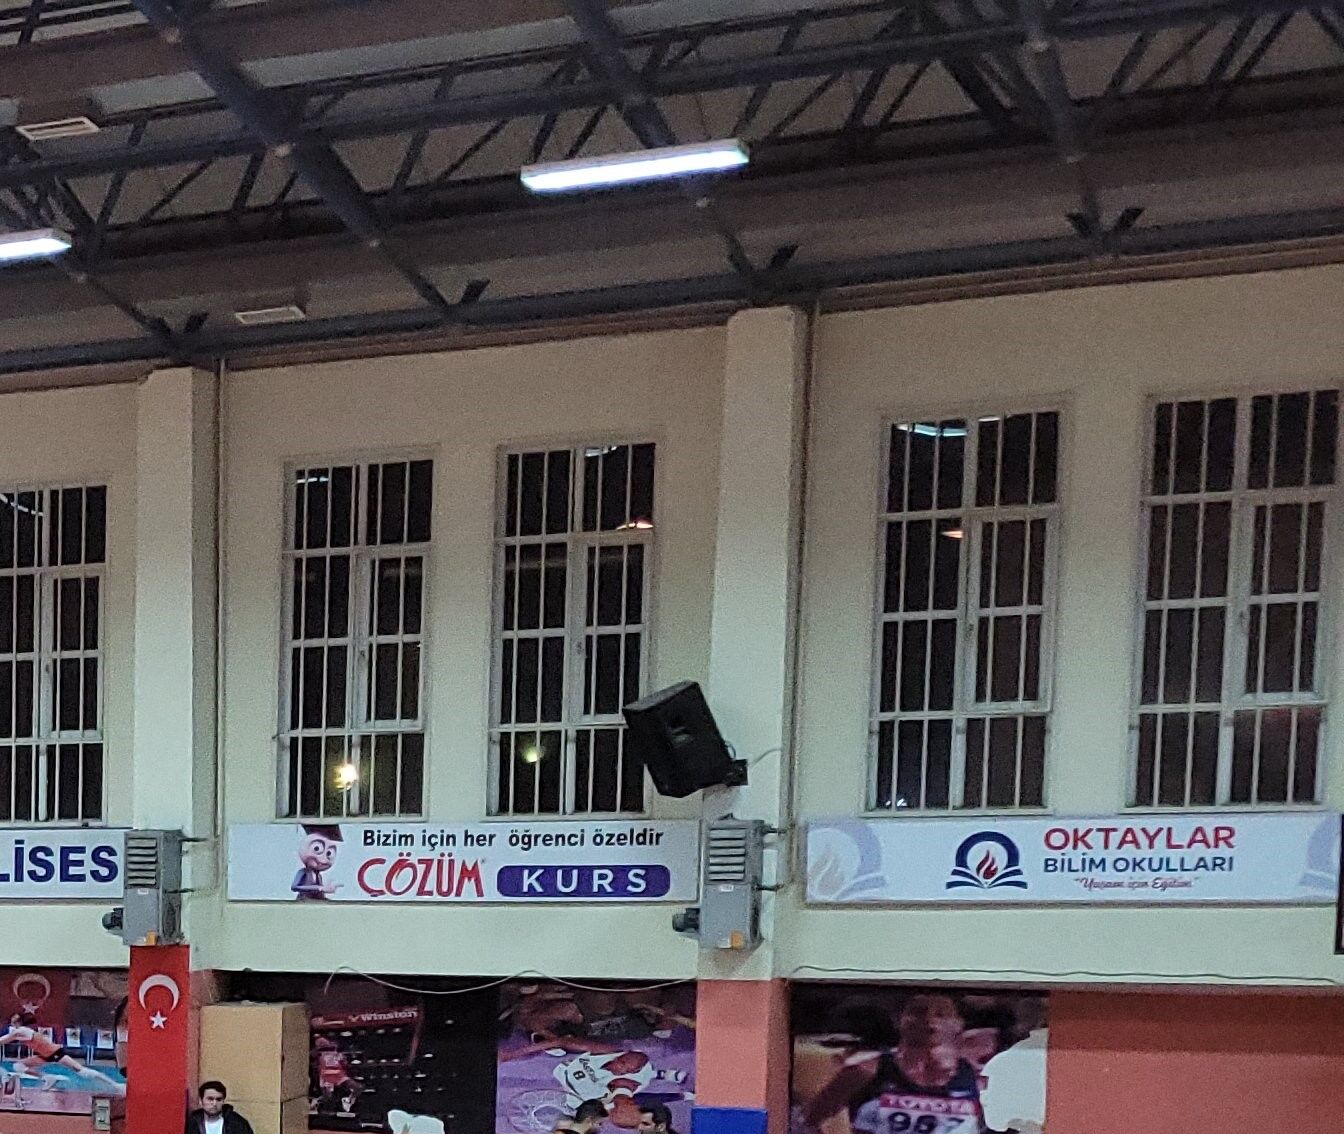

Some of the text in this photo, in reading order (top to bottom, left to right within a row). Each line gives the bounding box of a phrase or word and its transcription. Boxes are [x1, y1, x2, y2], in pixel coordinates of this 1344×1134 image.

[362, 827, 664, 851] Bizim için her öğrenci özeldir
[1043, 825, 1236, 851] OKTAYLAR
[356, 851, 648, 898] ÇÖZÜM KURS
[1043, 853, 1235, 873] BİLİM OKULLARI
